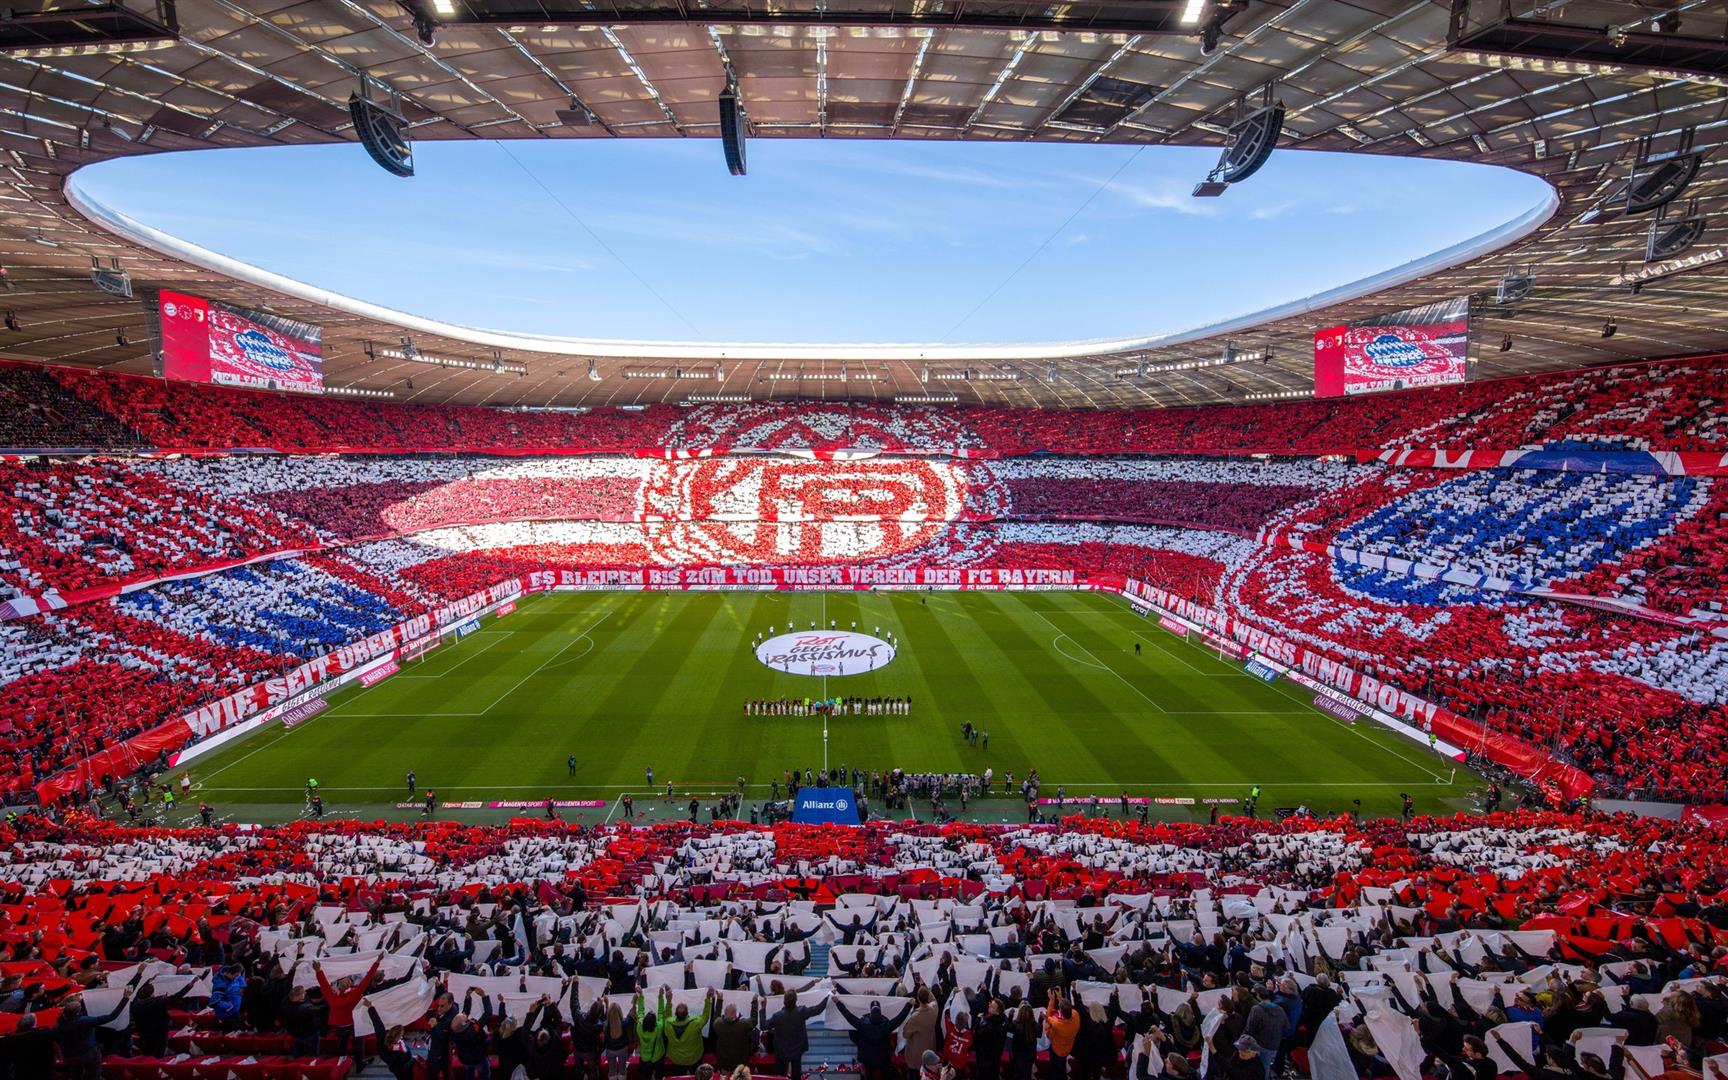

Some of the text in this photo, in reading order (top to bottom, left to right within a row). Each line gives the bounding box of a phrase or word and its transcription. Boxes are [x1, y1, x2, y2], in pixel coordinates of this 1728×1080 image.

[530, 570, 555, 586] ES
[649, 570, 680, 584] BIS
[686, 568, 726, 584] ZUM
[733, 569, 776, 584] TOD.
[784, 569, 842, 584] UNSER
[850, 569, 915, 584] VEREIN
[924, 569, 960, 584] DER
[968, 570, 991, 584] FC
[999, 570, 1074, 584] BAYERN
[769, 644, 882, 663] RASSISMUS
[790, 641, 844, 653] GEGEN
[184, 687, 257, 737] WIE
[265, 655, 327, 704] SEIT
[399, 614, 430, 642] 100
[488, 579, 521, 602] WIRD
[1142, 583, 1168, 609] DEN
[1168, 593, 1228, 637] FARBEN
[1230, 619, 1296, 666] WEISS
[1301, 650, 1352, 693] UND
[1357, 674, 1437, 733] ROT!
[1244, 659, 1268, 678] Allianz
[281, 697, 327, 726] QATAR AIRWAYS
[1313, 694, 1359, 722] QATAR AIRWAYS
[802, 801, 834, 809] Allianz
[951, 1039, 963, 1054] 21
